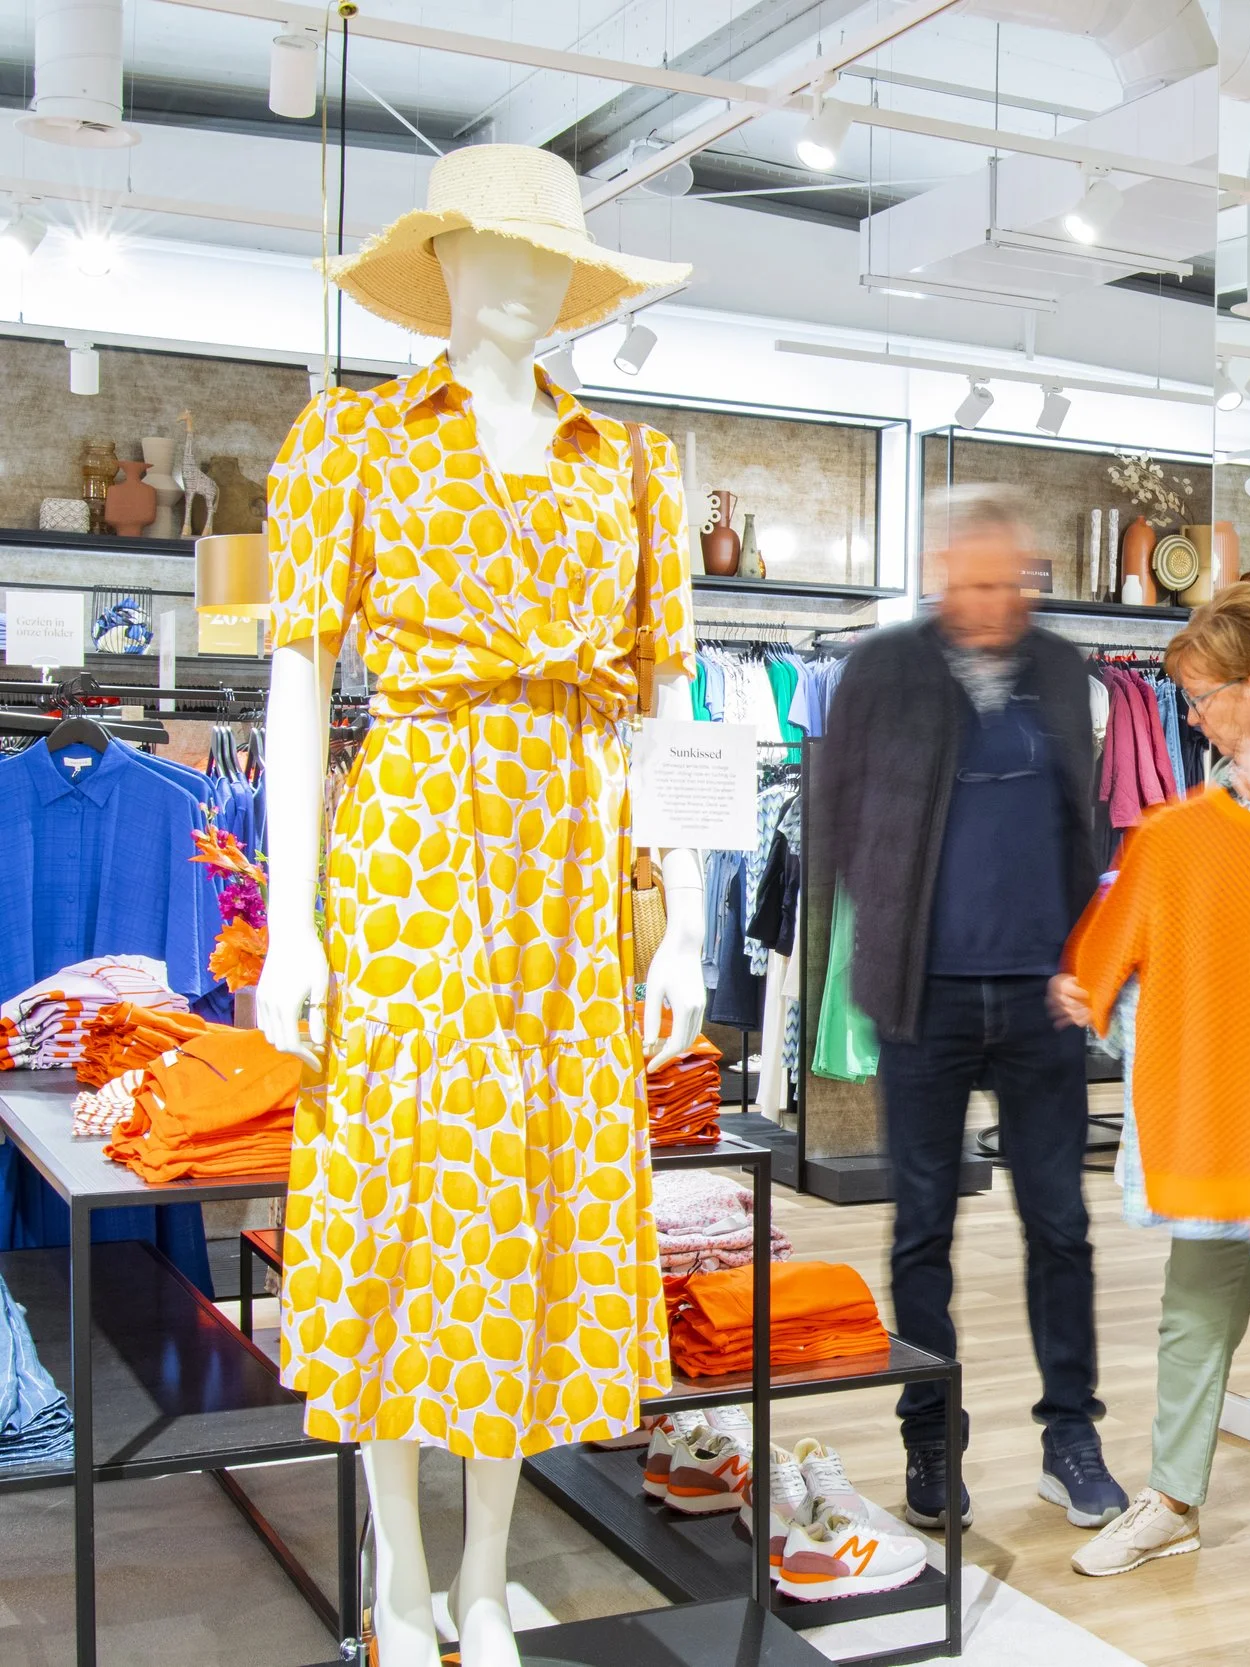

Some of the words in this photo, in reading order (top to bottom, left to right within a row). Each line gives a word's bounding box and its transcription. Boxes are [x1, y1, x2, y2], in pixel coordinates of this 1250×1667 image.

[16, 615, 52, 627] Gezien
[55, 616, 65, 627] in
[16, 628, 41, 637] onze
[43, 627, 75, 638] folder
[669, 746, 722, 760] Sunkissed
